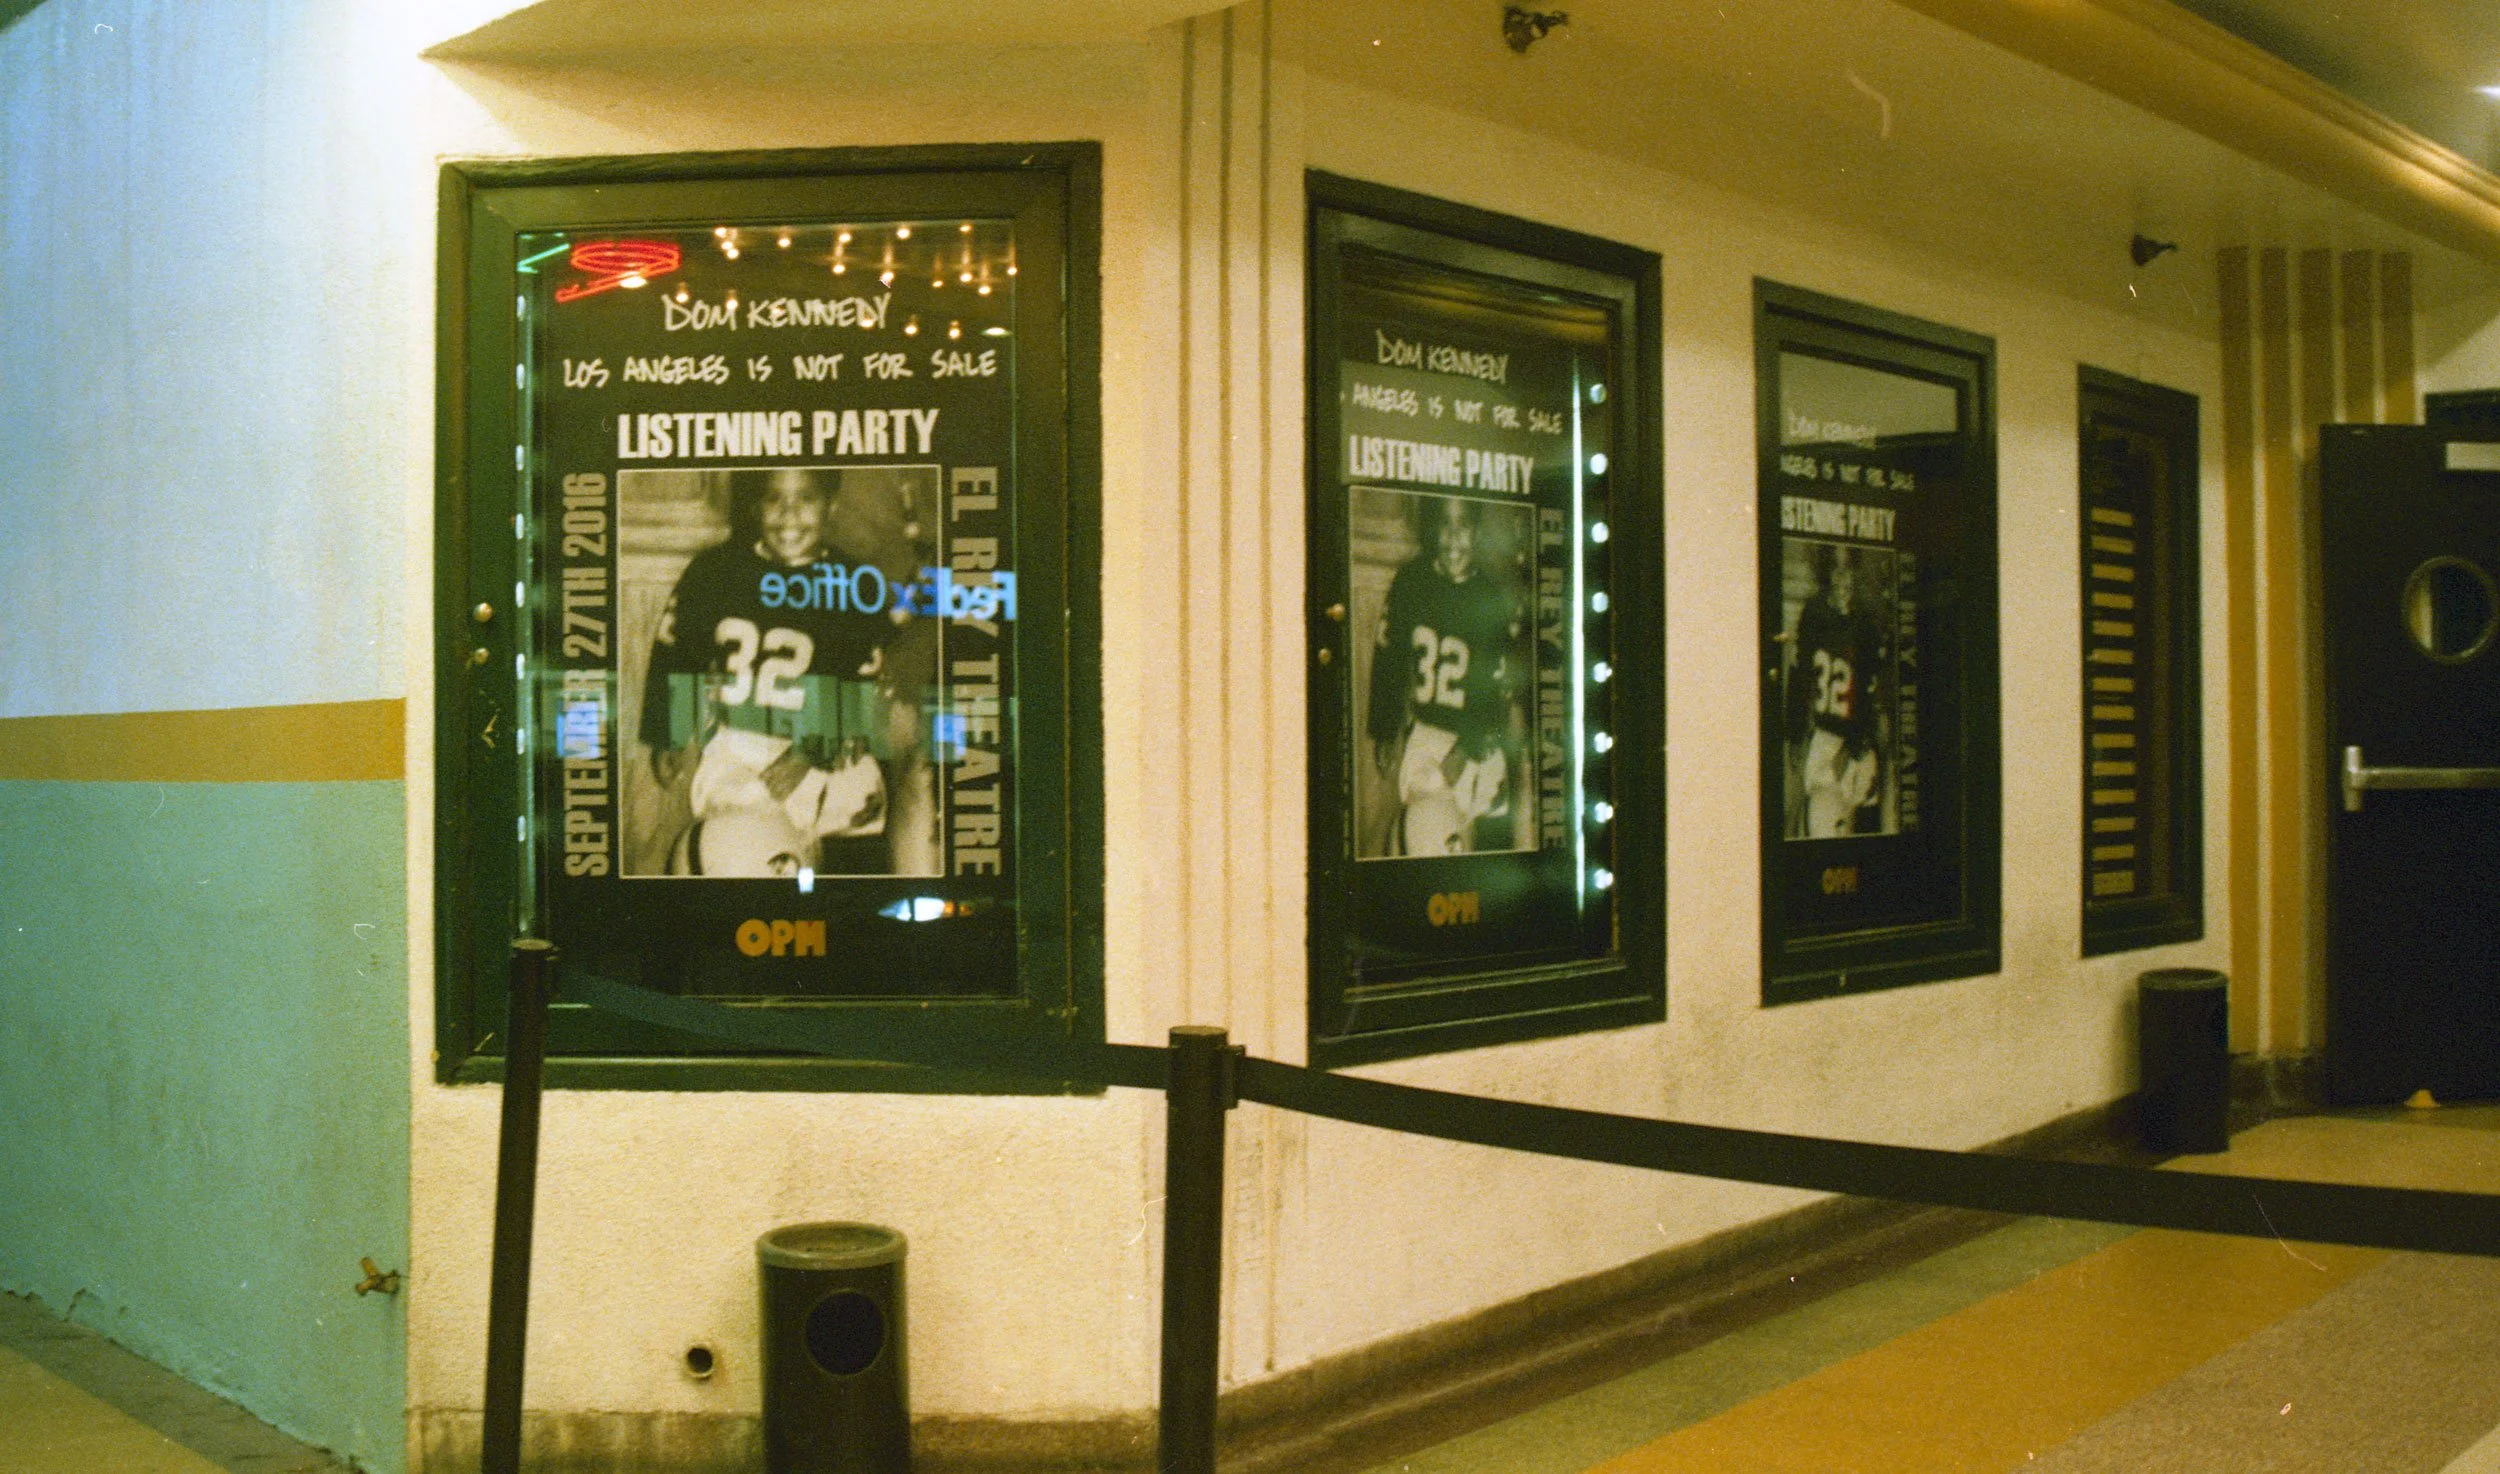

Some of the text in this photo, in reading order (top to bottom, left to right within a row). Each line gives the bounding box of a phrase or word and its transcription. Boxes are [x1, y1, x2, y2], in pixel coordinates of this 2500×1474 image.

[661, 292, 892, 332] DOM KENNEDY
[562, 348, 999, 389] LOS ANGELES IS NOT FOR SALE
[1375, 328, 1510, 384] DOM KENNEDY
[617, 408, 940, 459] LISTENING PARTY
[950, 466, 999, 523] EL
[1349, 435, 1534, 495] LISTENING PARTY
[561, 471, 610, 878] SEPTEMBER 27TH 2016
[714, 617, 815, 711] 32
[1411, 625, 1470, 709] 32
[1812, 649, 1854, 719] 32
[952, 653, 1002, 877] THEATRE
[1540, 666, 1565, 851] THEATRE
[735, 919, 827, 957] OPM
